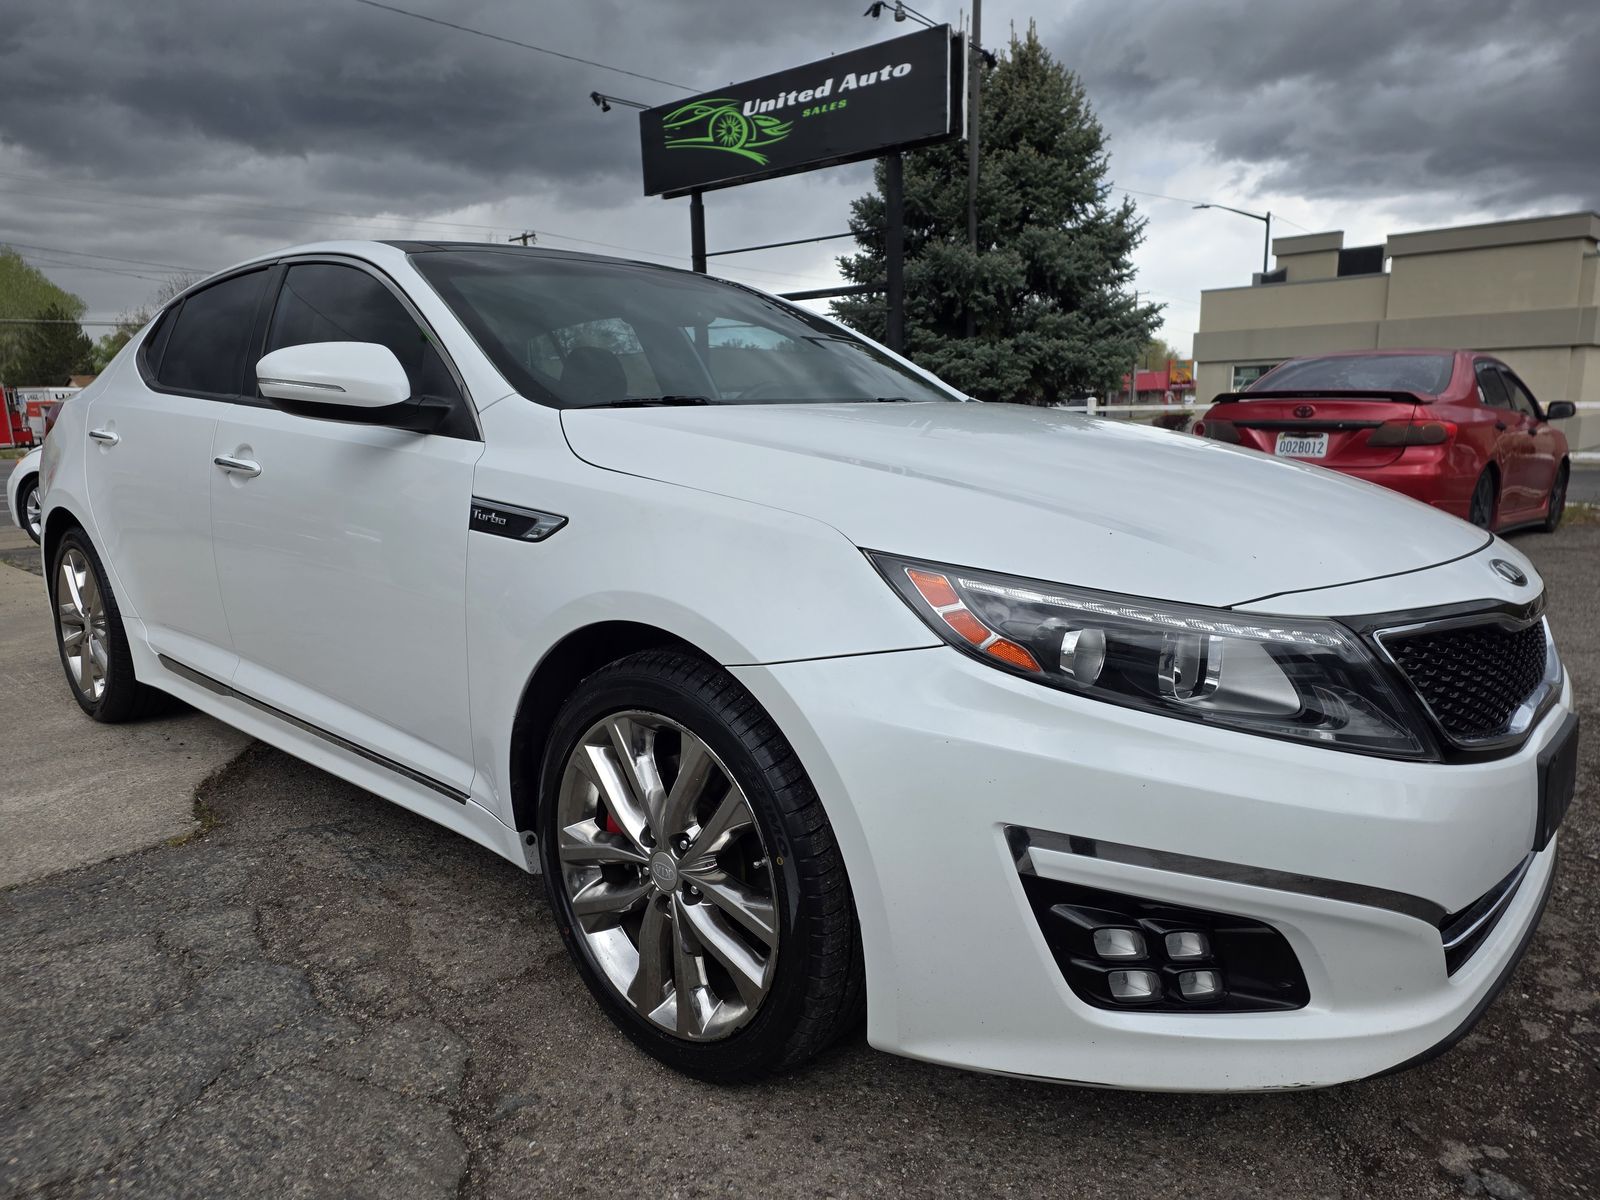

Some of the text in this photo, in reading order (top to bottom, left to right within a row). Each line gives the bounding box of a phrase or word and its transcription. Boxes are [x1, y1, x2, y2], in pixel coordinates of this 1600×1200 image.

[742, 63, 912, 117] United Auto
[802, 99, 847, 118] SALES
[472, 508, 507, 525] Turbo
